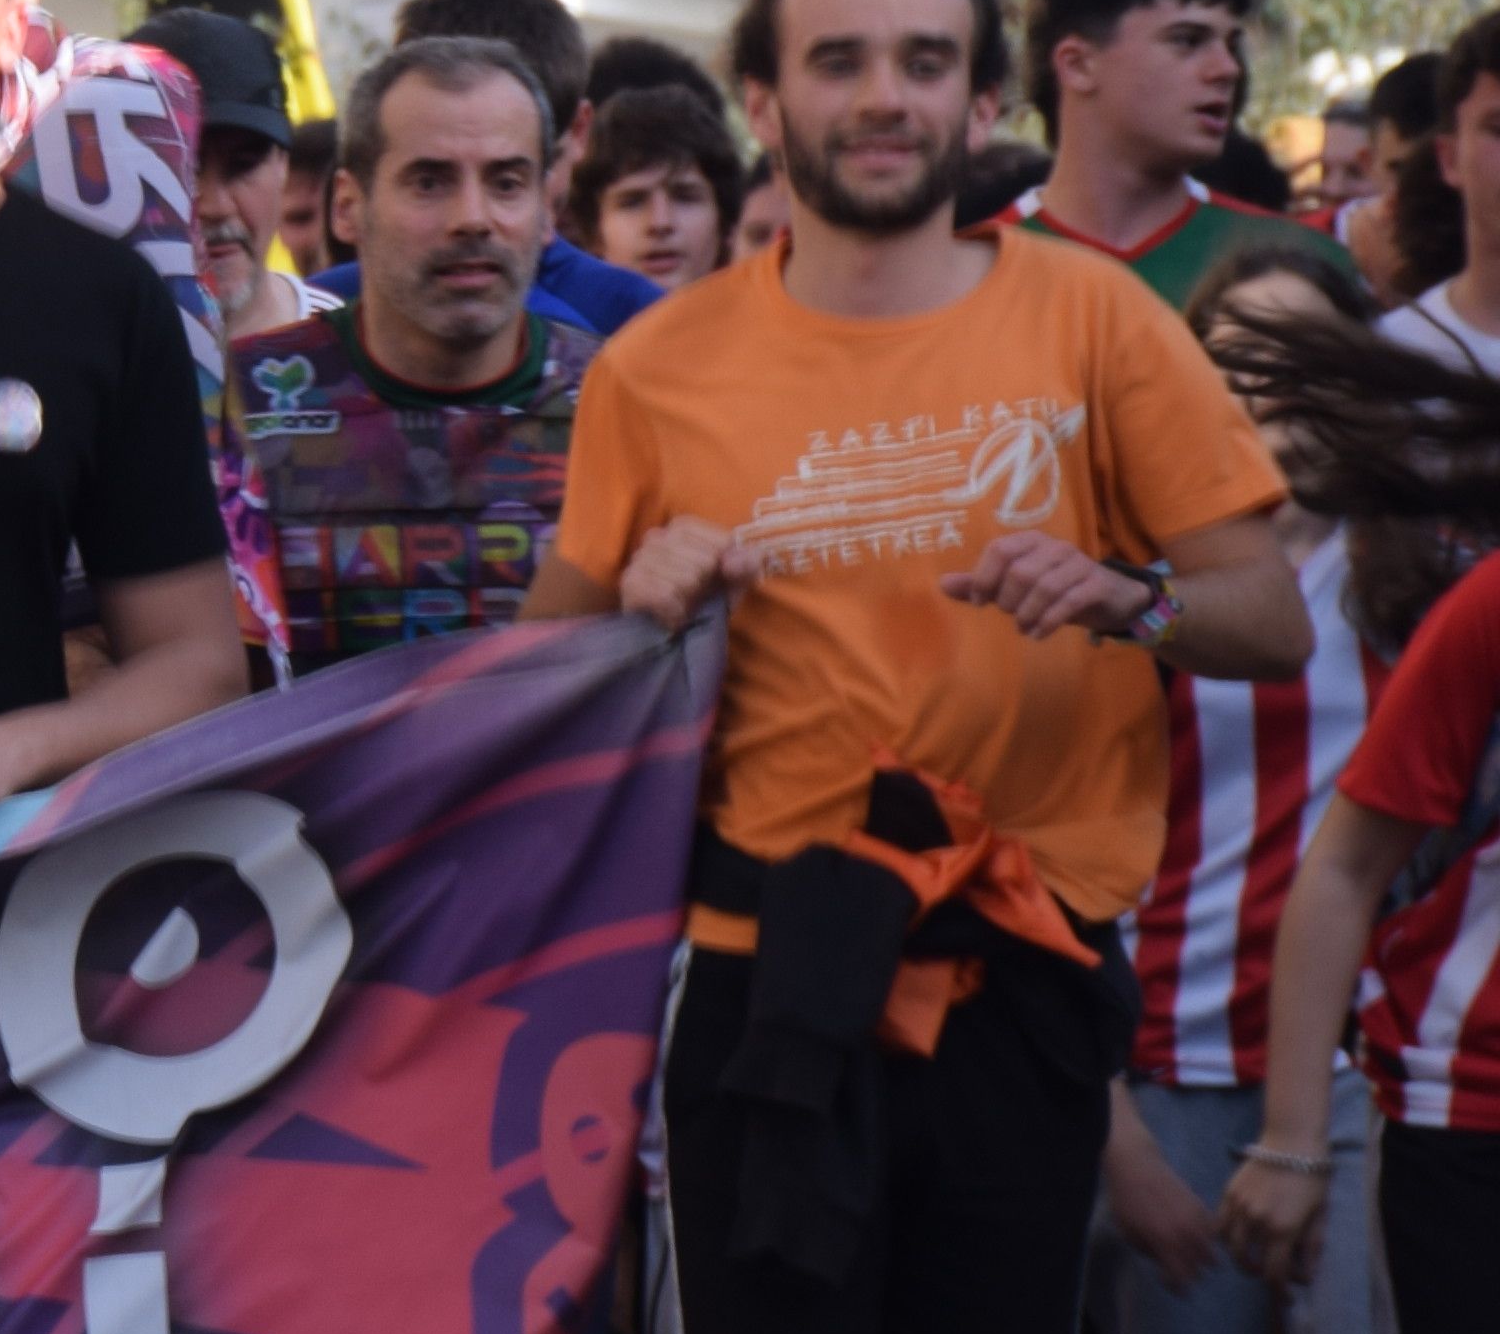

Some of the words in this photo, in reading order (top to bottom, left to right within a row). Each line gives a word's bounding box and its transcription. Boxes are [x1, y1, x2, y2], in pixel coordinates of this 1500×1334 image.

[806, 414, 938, 454] ZAZPI
[280, 521, 560, 588] HARR
[759, 519, 963, 577] AZTETXEA
